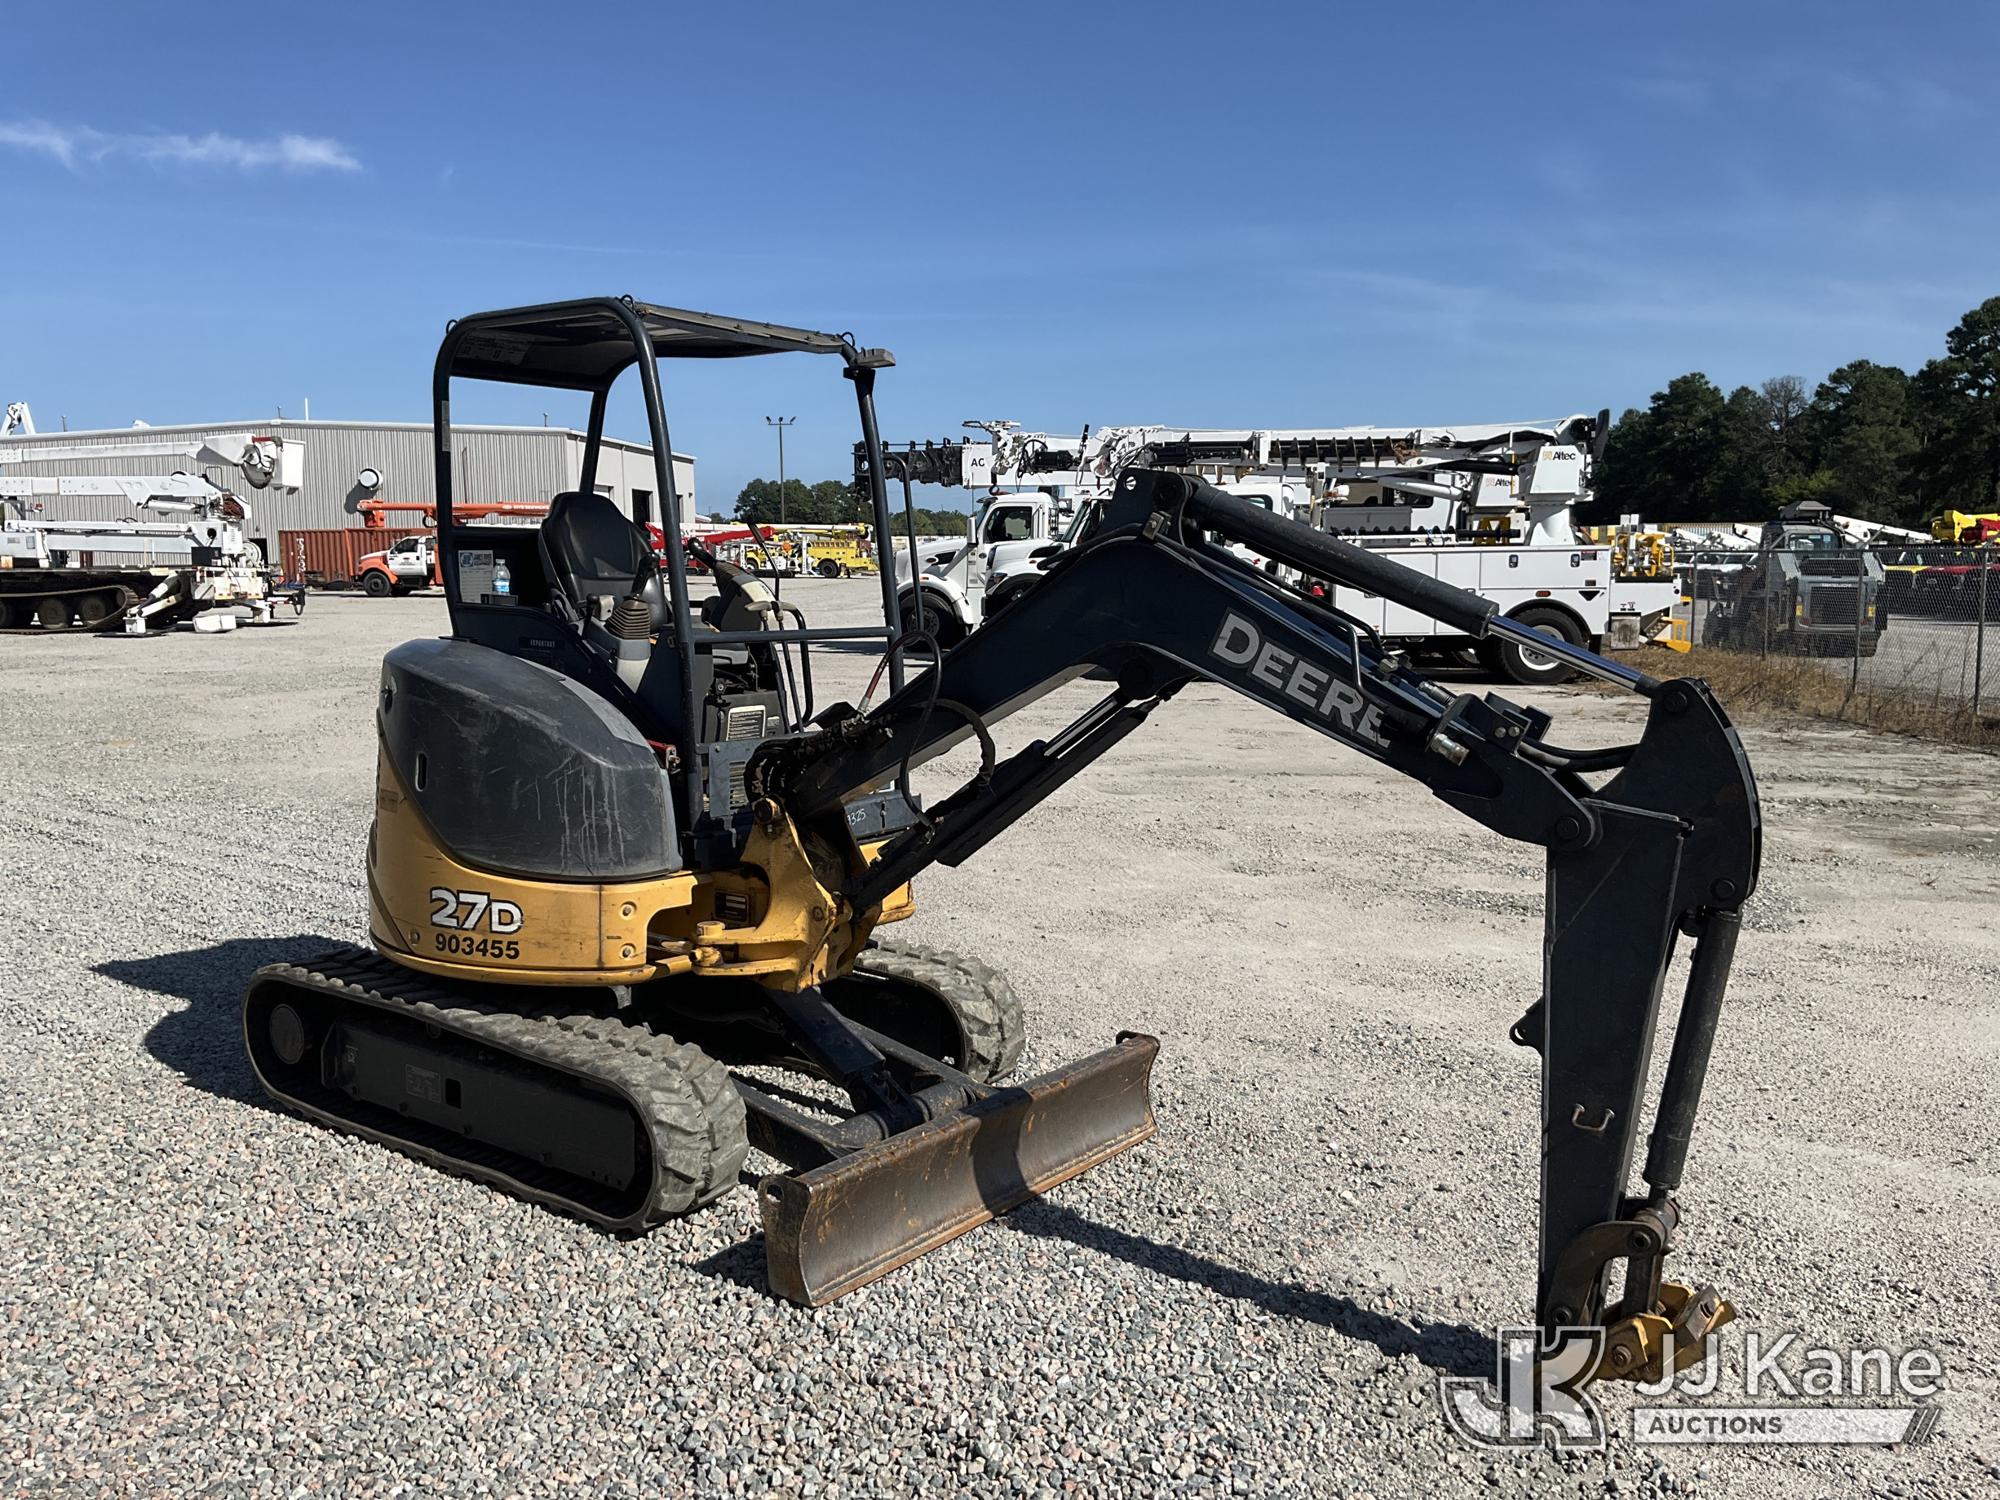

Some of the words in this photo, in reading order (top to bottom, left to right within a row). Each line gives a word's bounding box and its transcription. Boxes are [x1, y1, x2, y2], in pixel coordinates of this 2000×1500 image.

[971, 457, 986, 467] AC
[1552, 451, 1576, 461] Altec
[1212, 612, 1391, 748] DEERE
[430, 886, 524, 934] 27D
[435, 933, 520, 960] 903455
